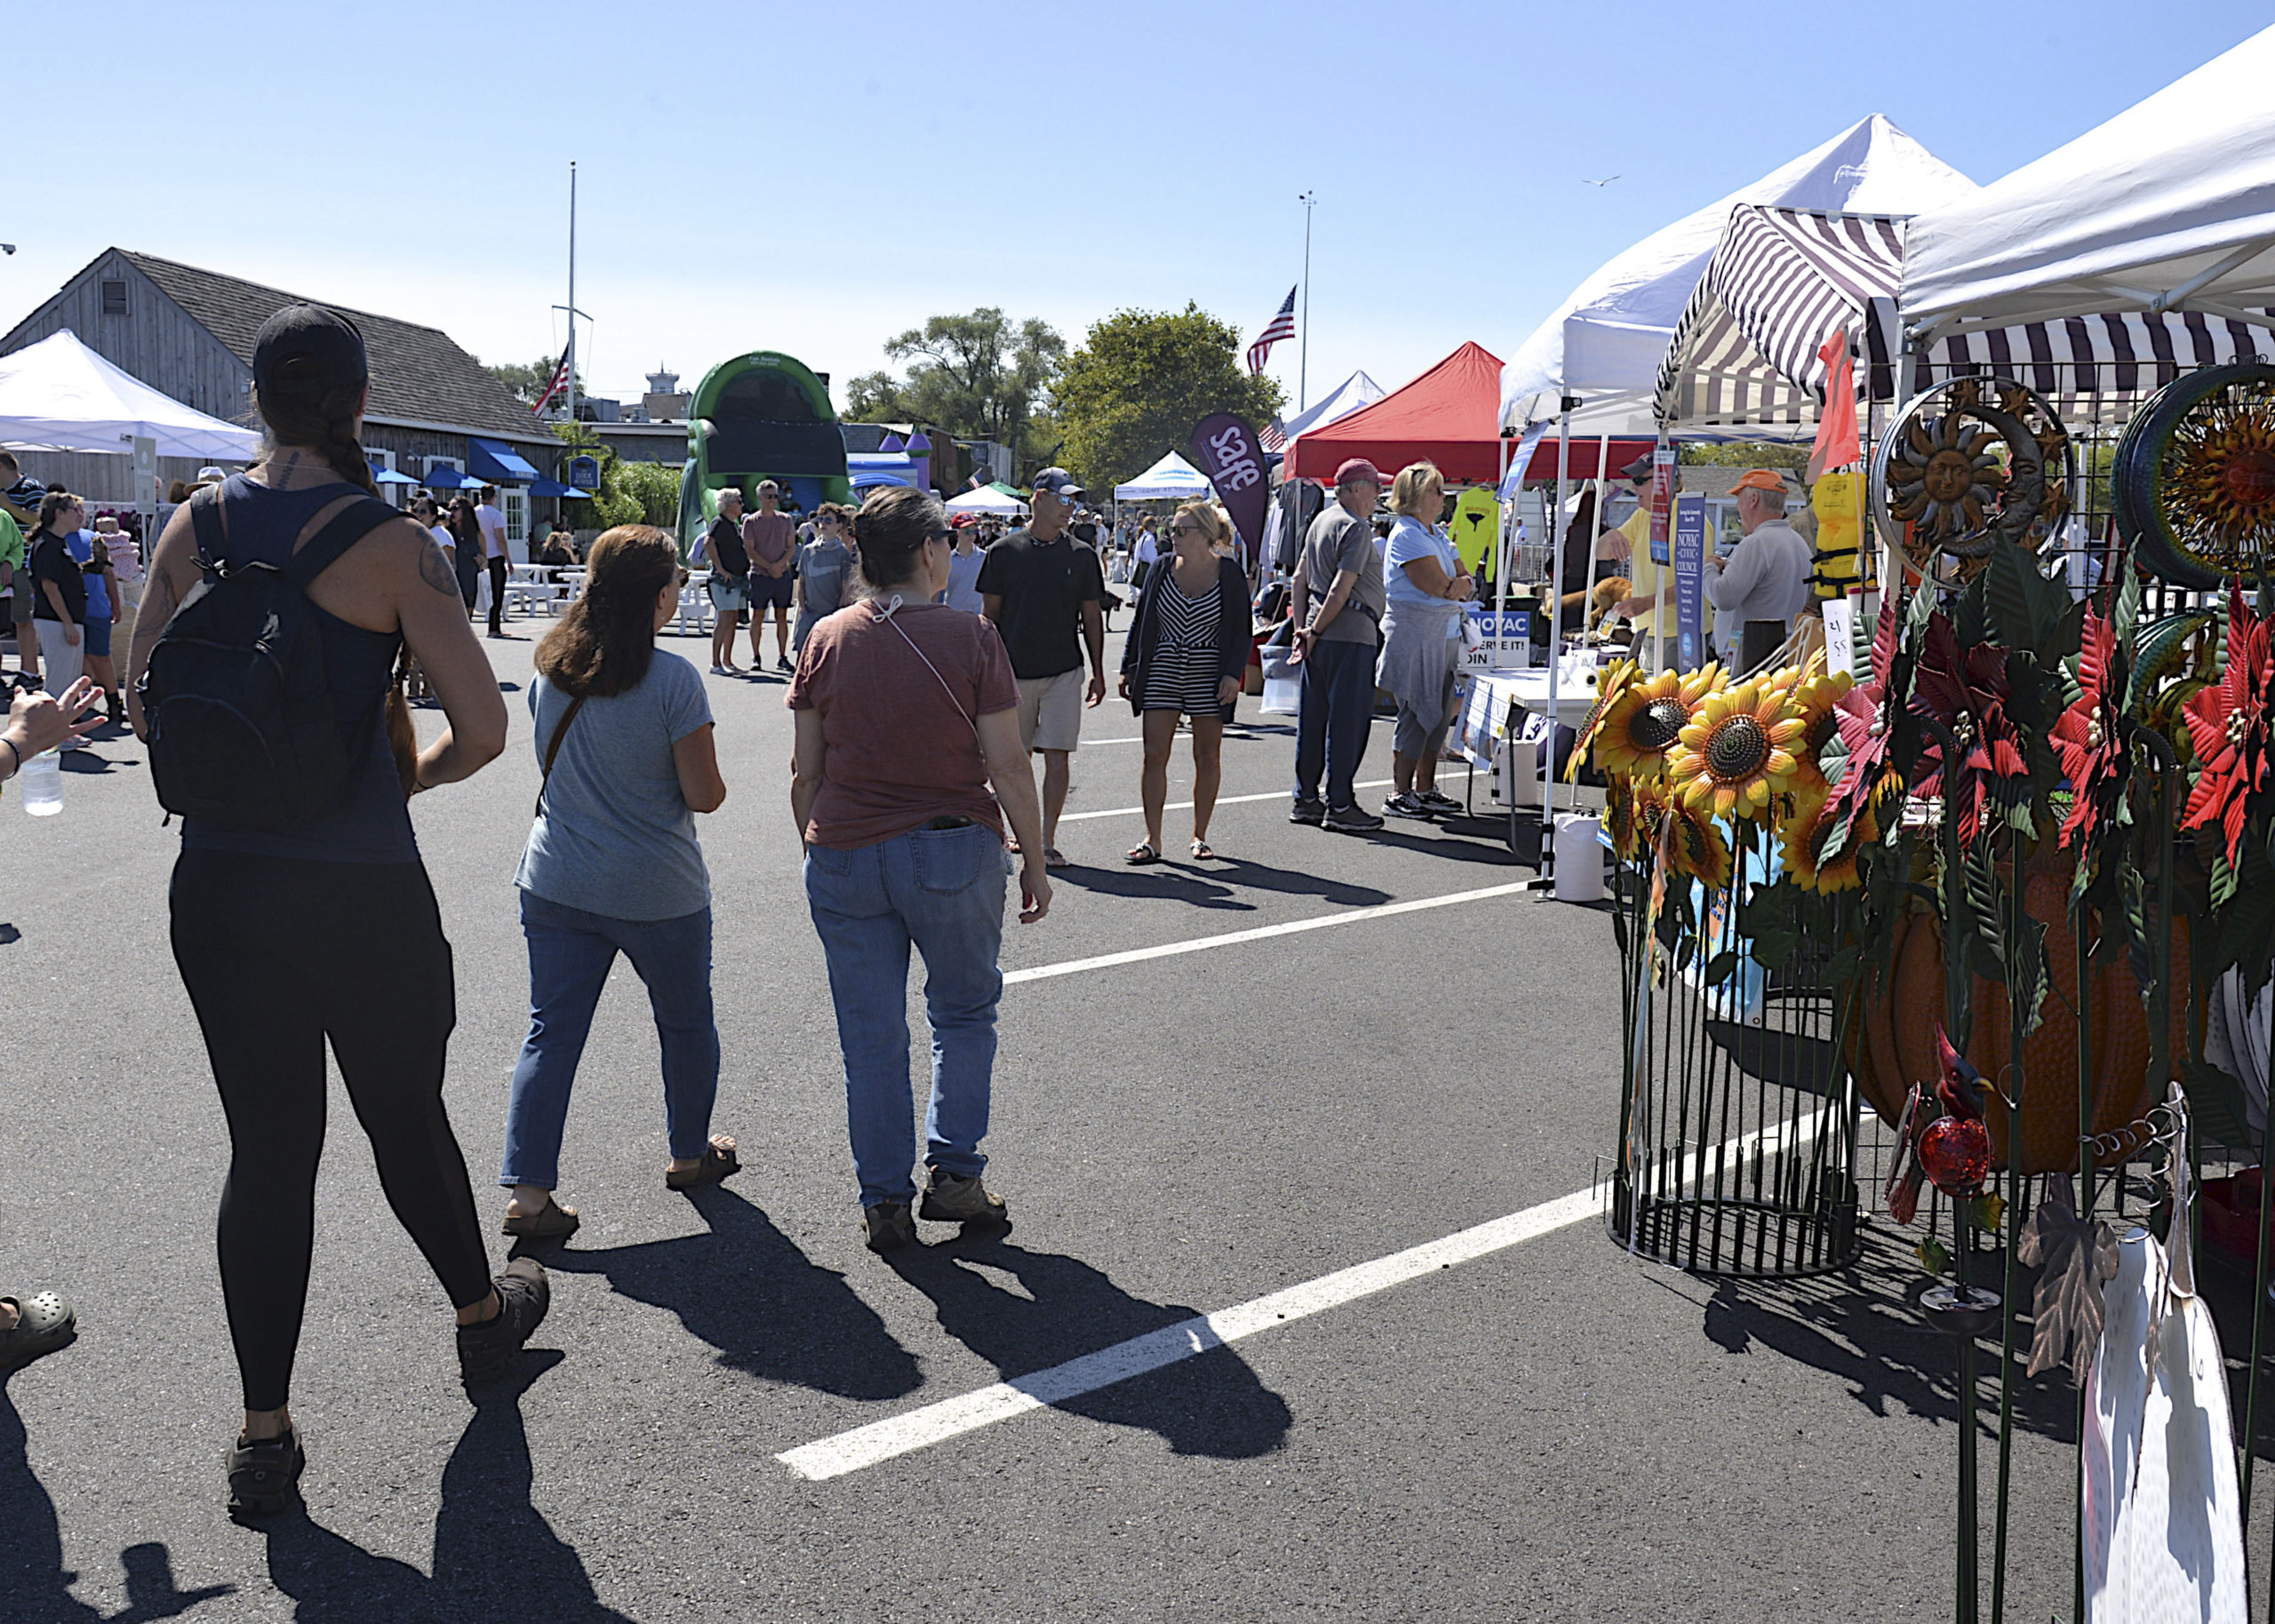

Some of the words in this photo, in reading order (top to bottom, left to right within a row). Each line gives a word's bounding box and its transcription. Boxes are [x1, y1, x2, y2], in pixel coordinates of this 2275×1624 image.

[1209, 426, 1260, 491] safe
[1677, 533, 1700, 547] NOYAC
[1676, 561, 1698, 573] COUNCIL
[1511, 641, 1525, 650] IT!
[1467, 654, 1488, 665] OIN
